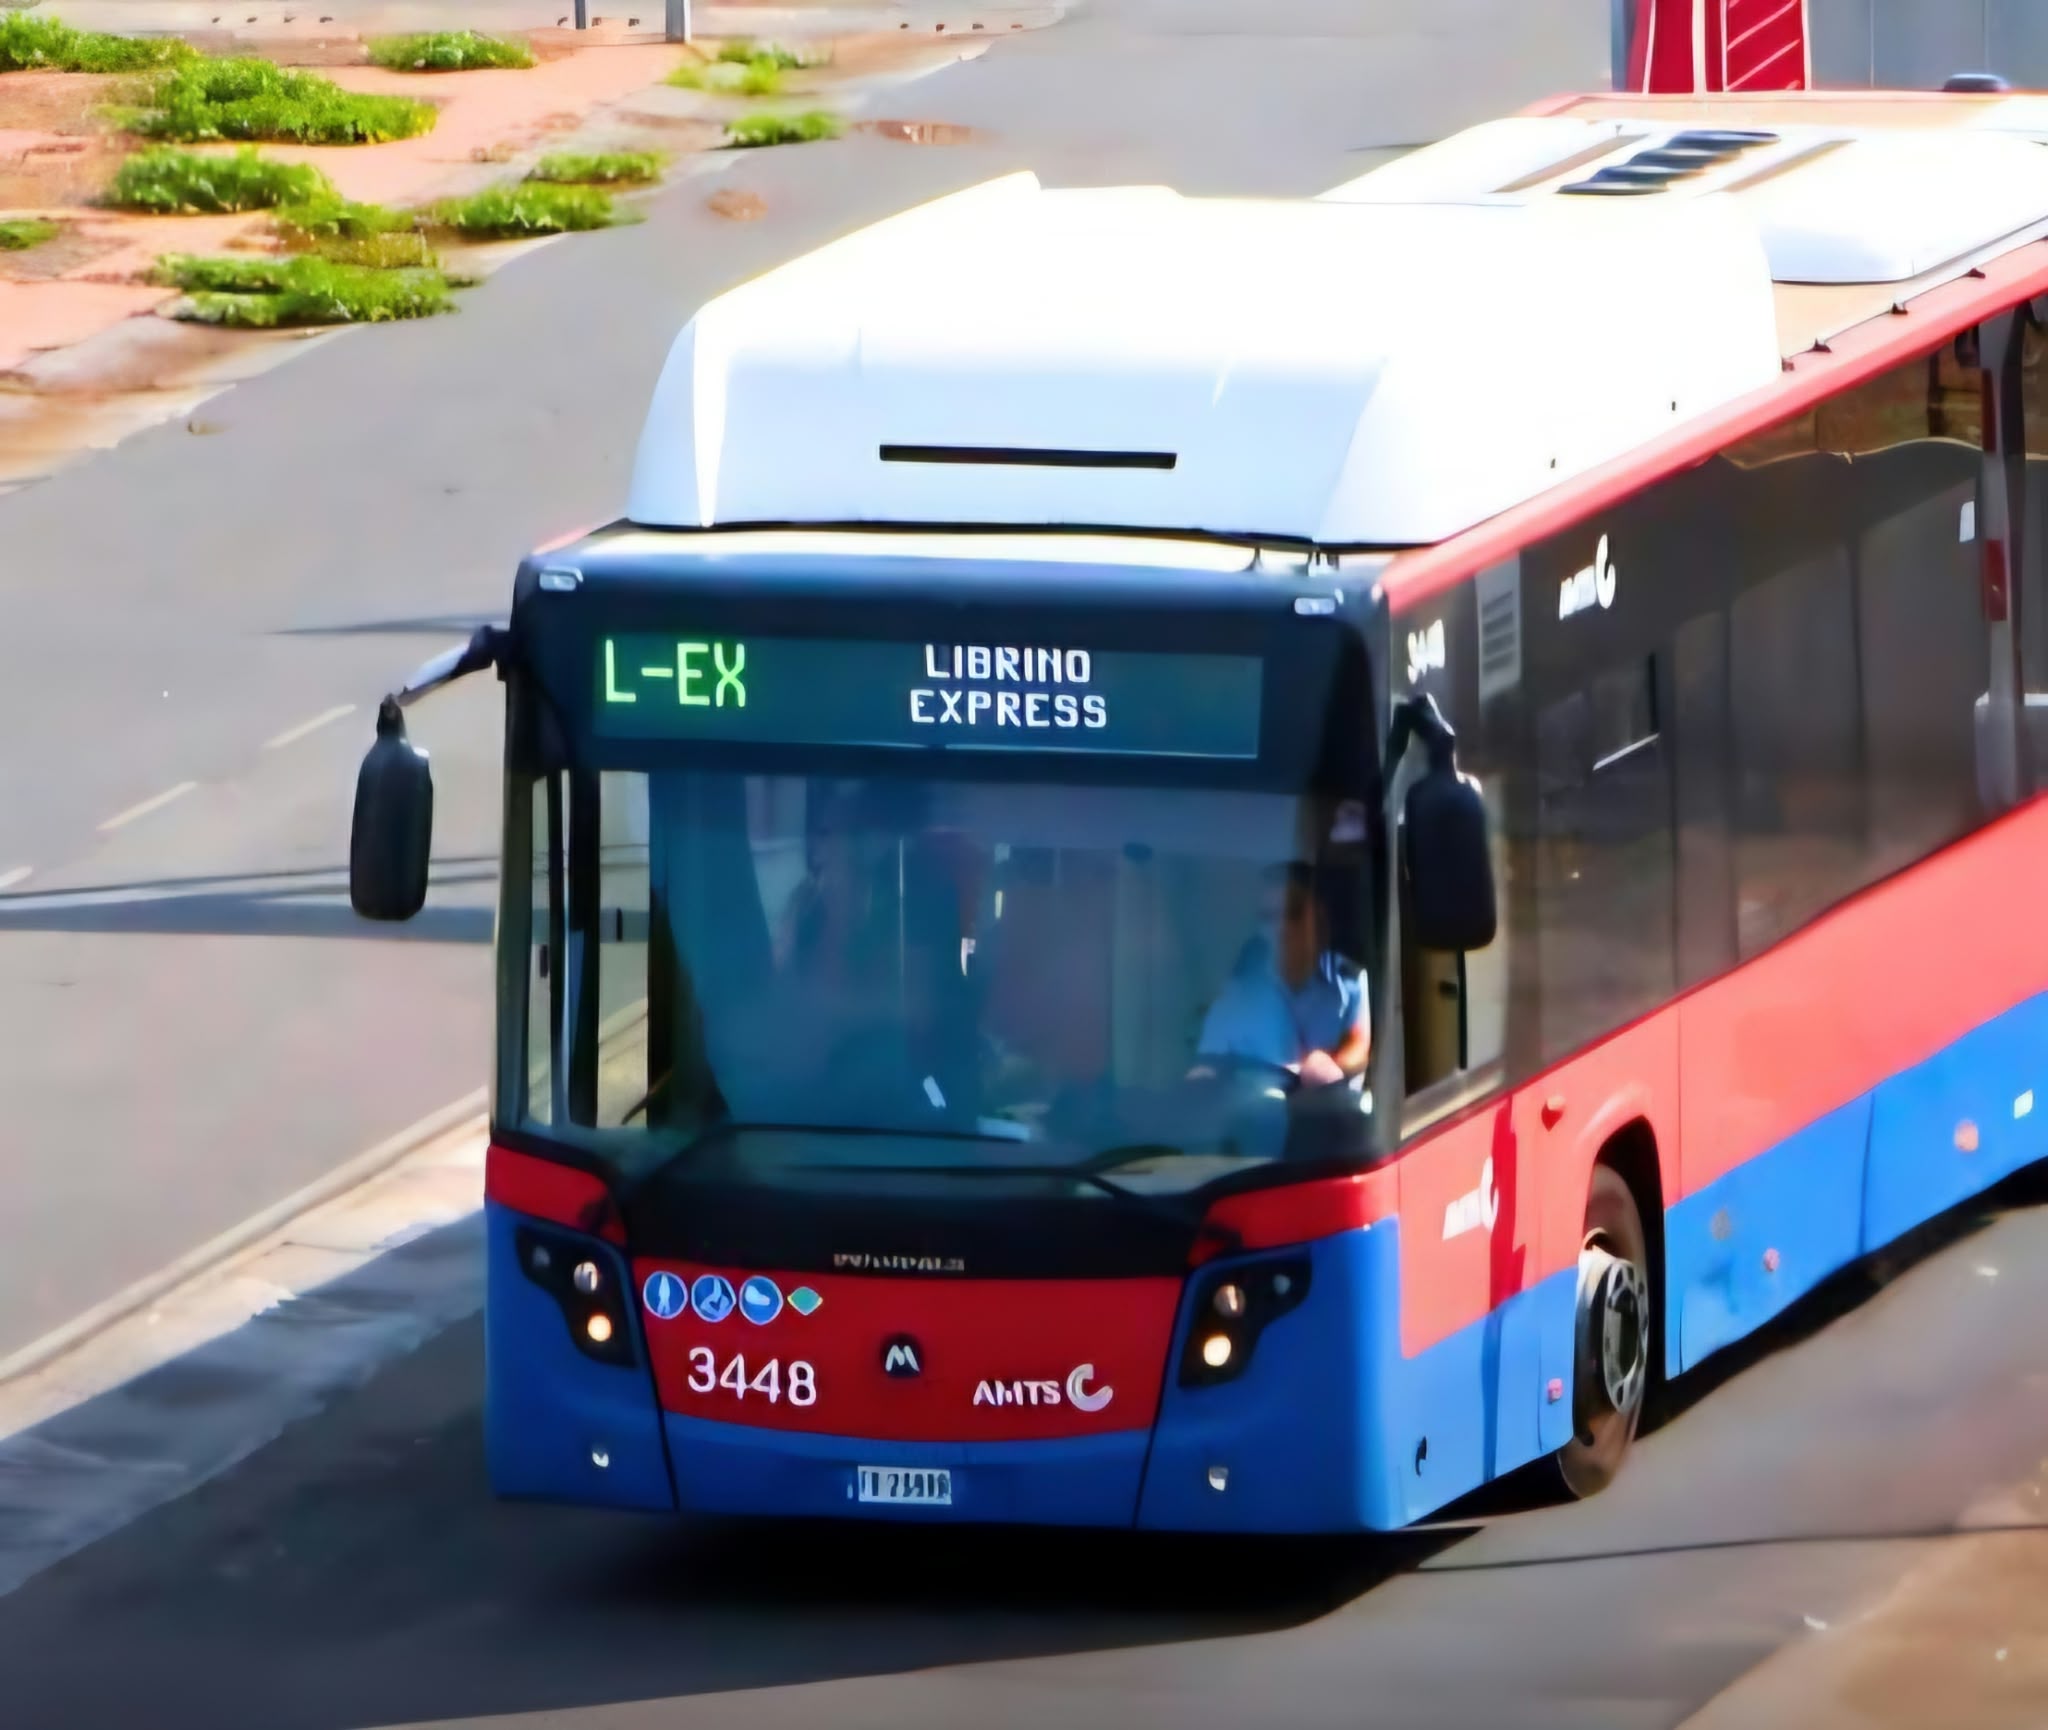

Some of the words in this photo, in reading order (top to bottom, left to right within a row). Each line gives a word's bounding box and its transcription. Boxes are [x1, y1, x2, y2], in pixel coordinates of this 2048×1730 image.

[605, 639, 746, 708] L-EX
[925, 643, 1091, 683] LIBRINO
[910, 688, 1107, 728] EXPRESS
[687, 1346, 817, 1406] 3448
[972, 1380, 1061, 1406] AMTS
